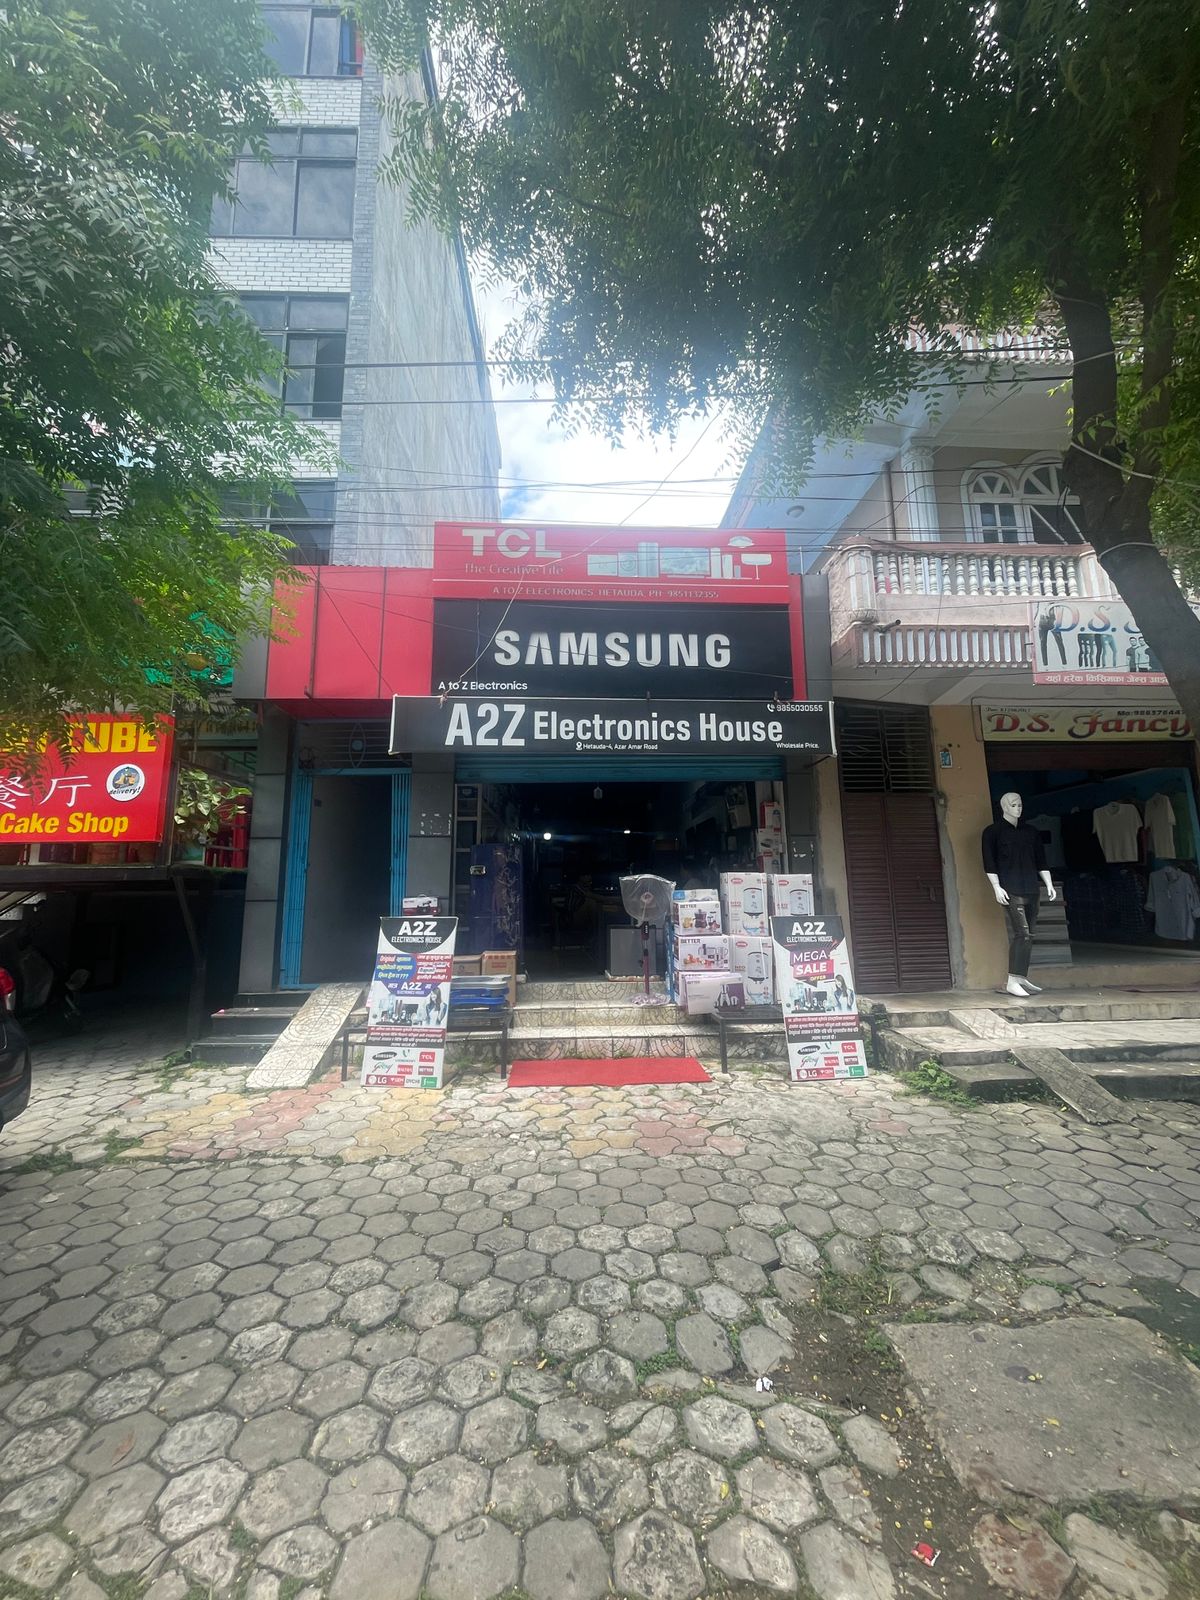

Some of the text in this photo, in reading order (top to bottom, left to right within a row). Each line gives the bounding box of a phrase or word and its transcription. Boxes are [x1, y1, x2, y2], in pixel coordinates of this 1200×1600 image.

[462, 528, 562, 558] TCL
[526, 587, 594, 596] ELECTRONICS
[1049, 603, 1116, 633] D.S.
[494, 630, 731, 668] SAMSUNG
[438, 681, 528, 690] A to Z Electronics
[776, 704, 823, 712] 9855030555
[444, 703, 783, 747] A2Z Electronics House
[987, 710, 1191, 739] D.S. Fancy
[0, 812, 129, 837] Cake Shop
[398, 921, 437, 935] A2Z
[792, 922, 827, 935] A2Z
[793, 950, 827, 963] MEGA
[796, 962, 827, 975] SALE
[401, 982, 422, 990] A2Z
